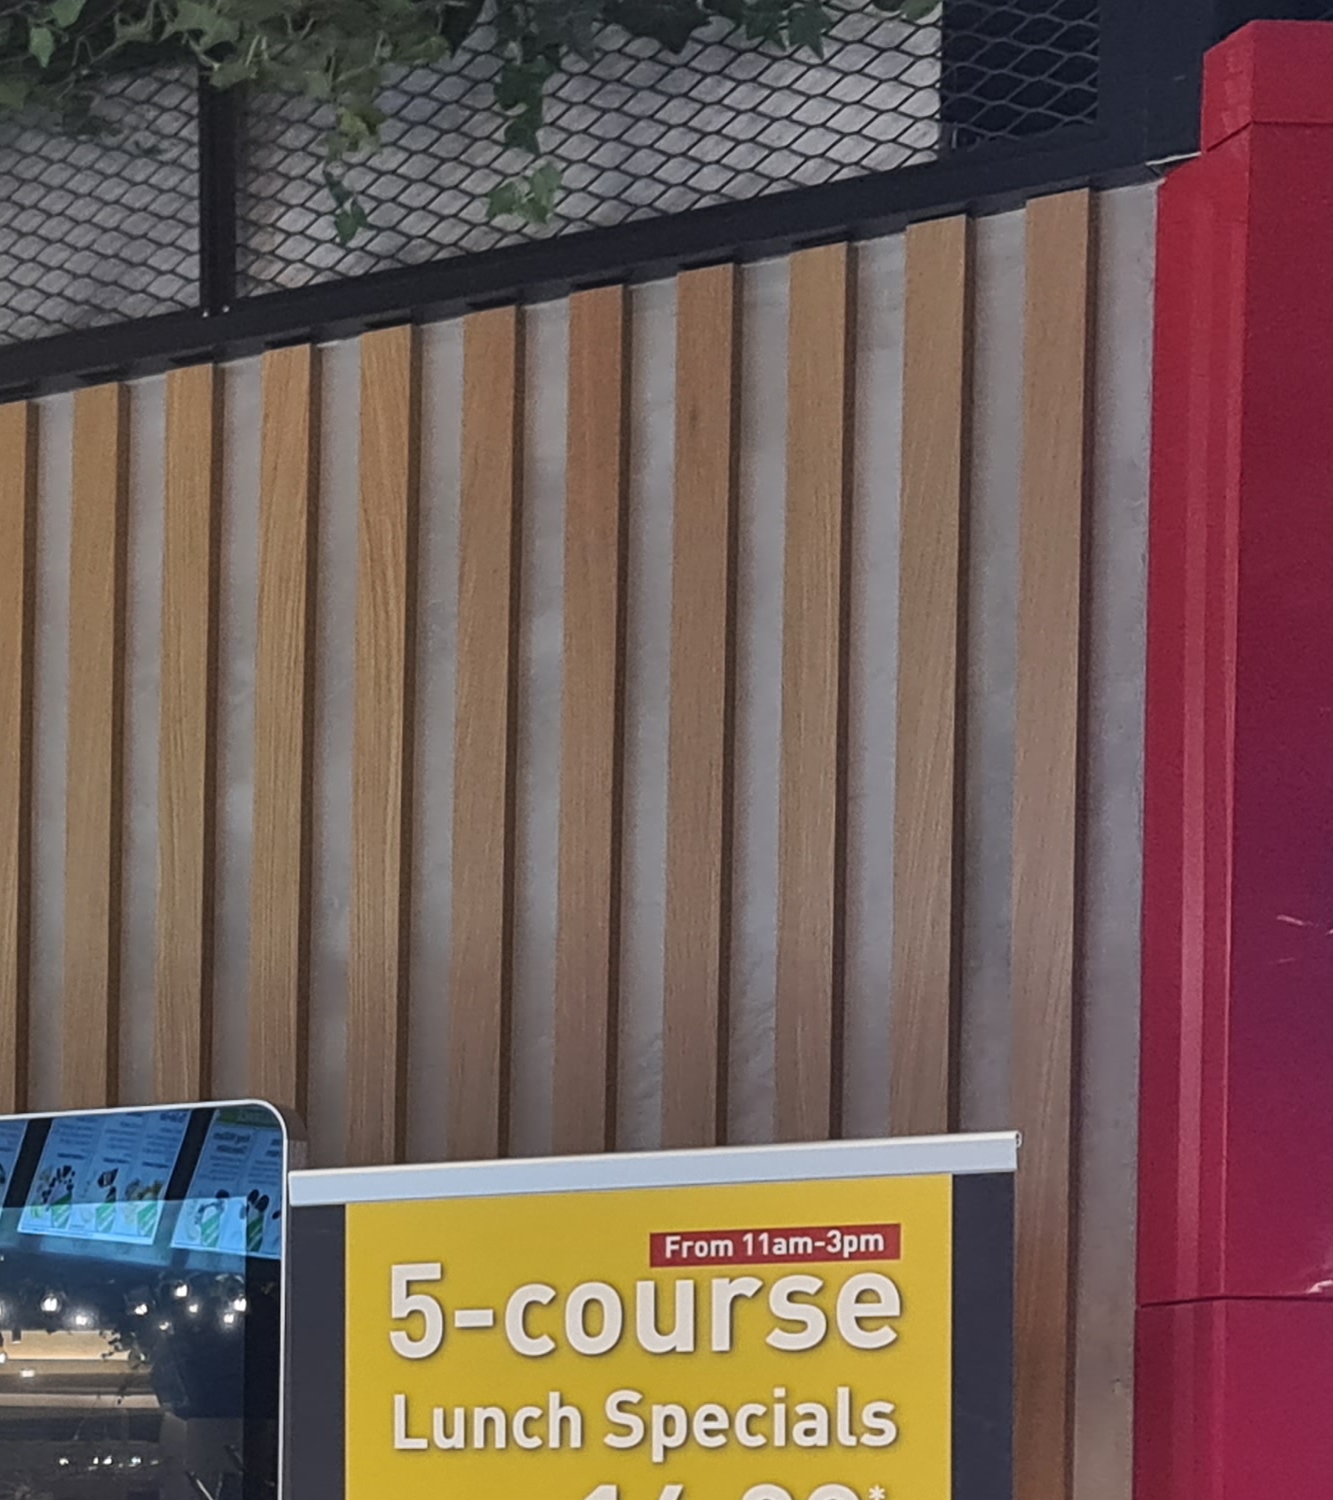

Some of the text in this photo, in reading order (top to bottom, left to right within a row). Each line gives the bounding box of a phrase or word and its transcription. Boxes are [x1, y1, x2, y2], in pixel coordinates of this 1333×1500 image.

[664, 1229, 885, 1260] From 11am-3pm
[388, 1263, 902, 1360] 5-course
[393, 1387, 899, 1462] Lunch Specials
